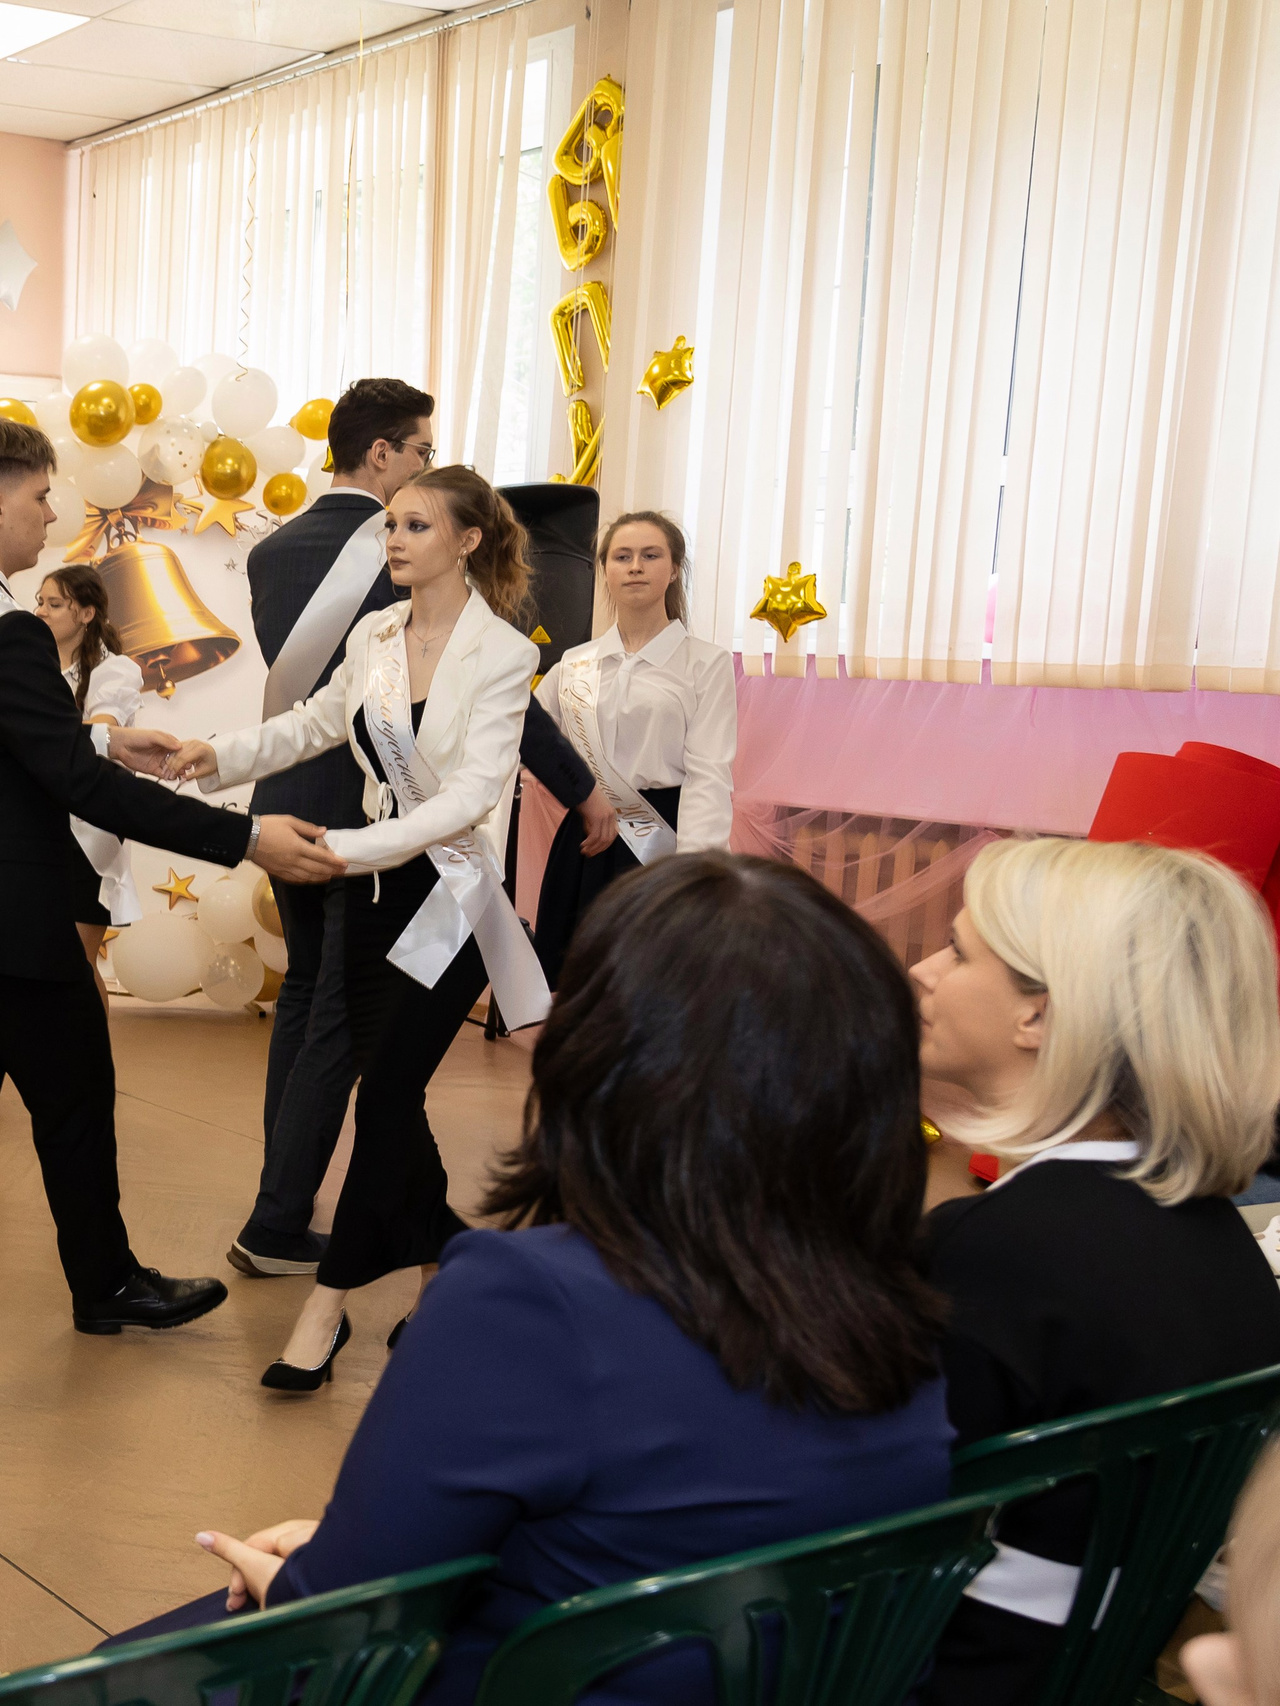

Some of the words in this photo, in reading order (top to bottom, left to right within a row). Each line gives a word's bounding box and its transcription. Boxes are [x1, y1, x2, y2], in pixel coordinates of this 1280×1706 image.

[365, 655, 428, 804] Выпускниц
[439, 828, 484, 863] 26
[616, 803, 664, 838] 2026
